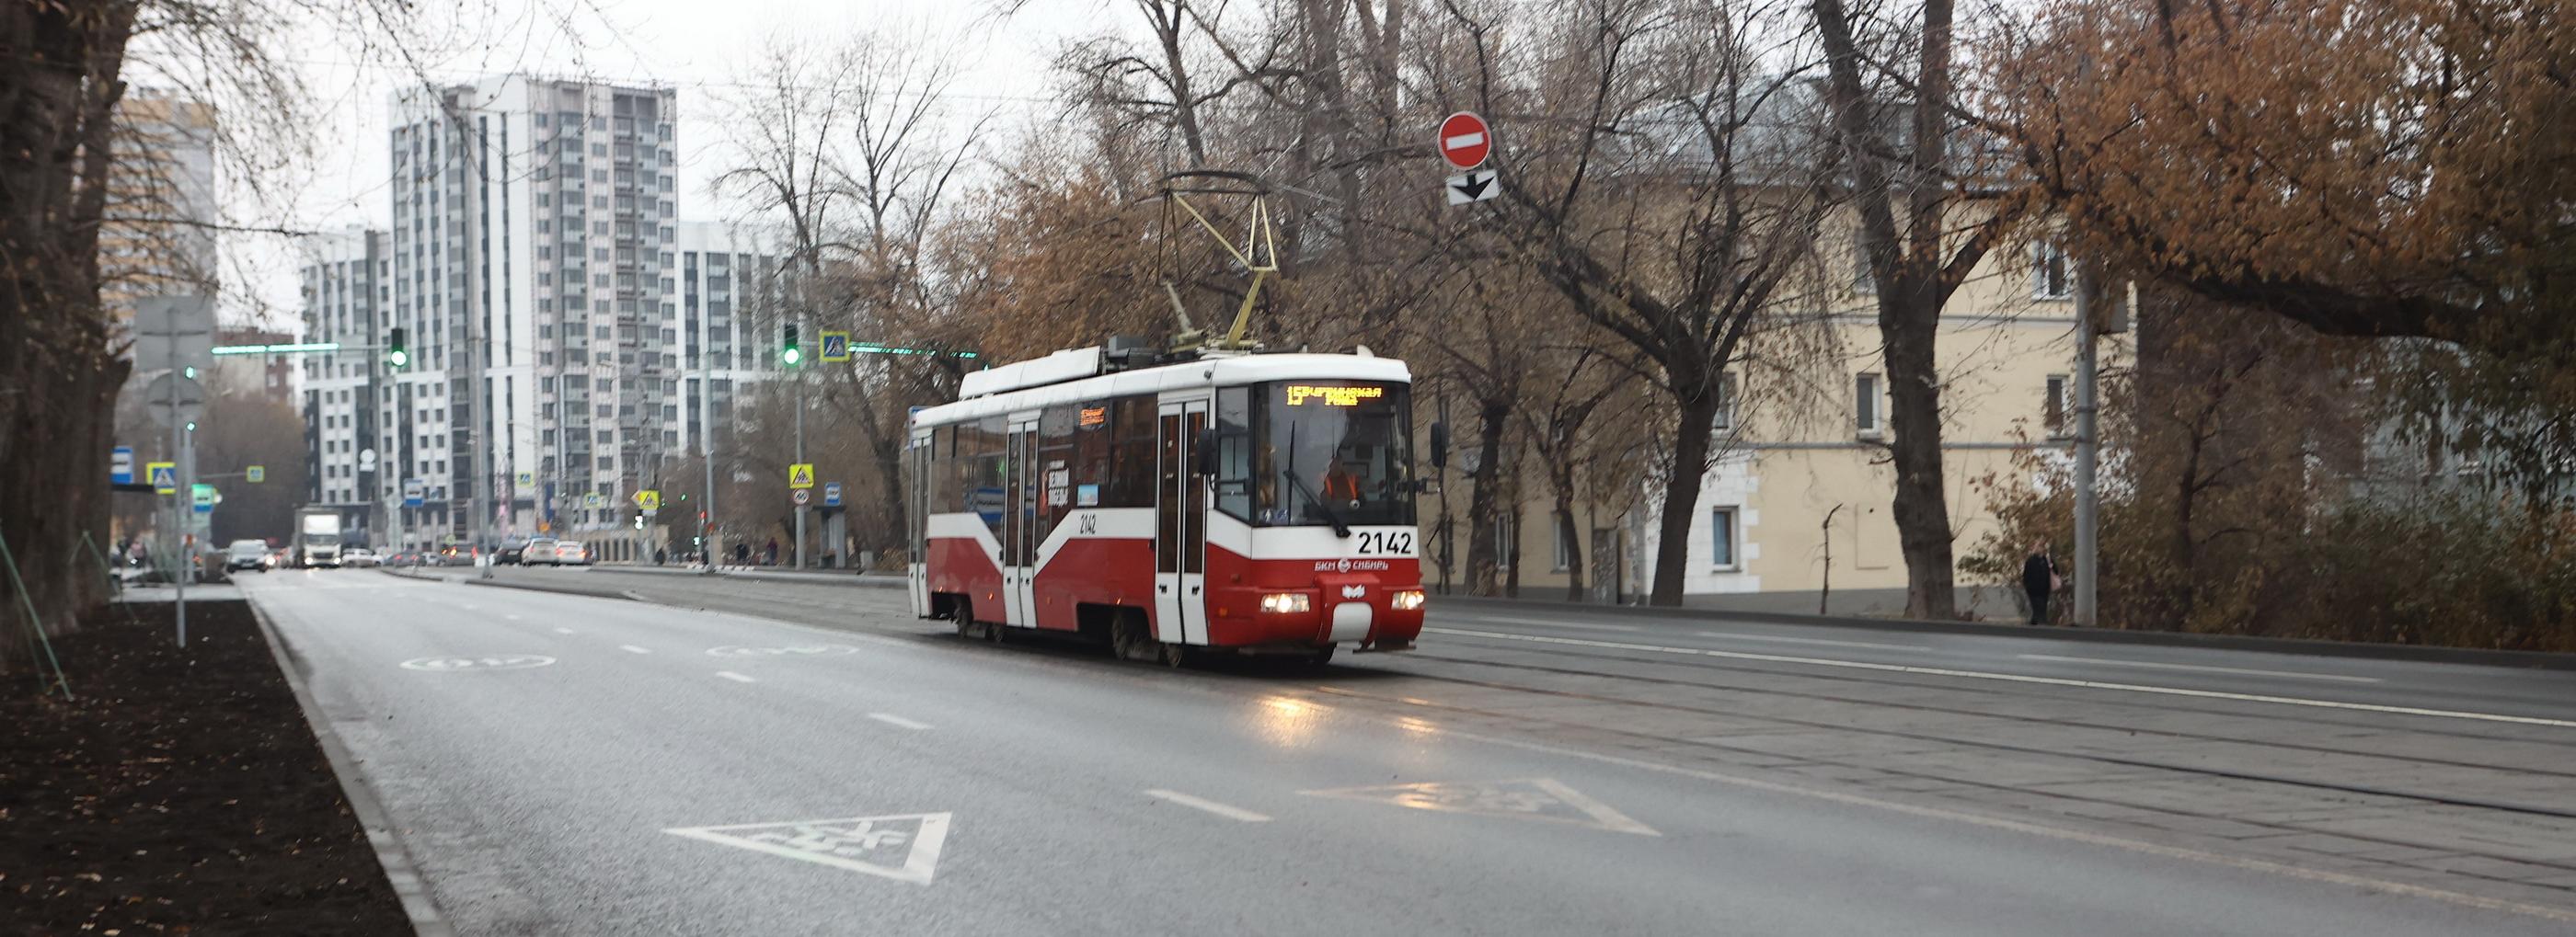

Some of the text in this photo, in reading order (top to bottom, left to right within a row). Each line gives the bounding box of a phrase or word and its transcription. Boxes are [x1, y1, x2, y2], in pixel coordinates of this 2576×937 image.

[1287, 386, 1303, 406] 15
[1079, 513, 1097, 534] 2142
[1358, 531, 1411, 554] 2142
[1314, 560, 1389, 572] БКМ СИБИРЬ
